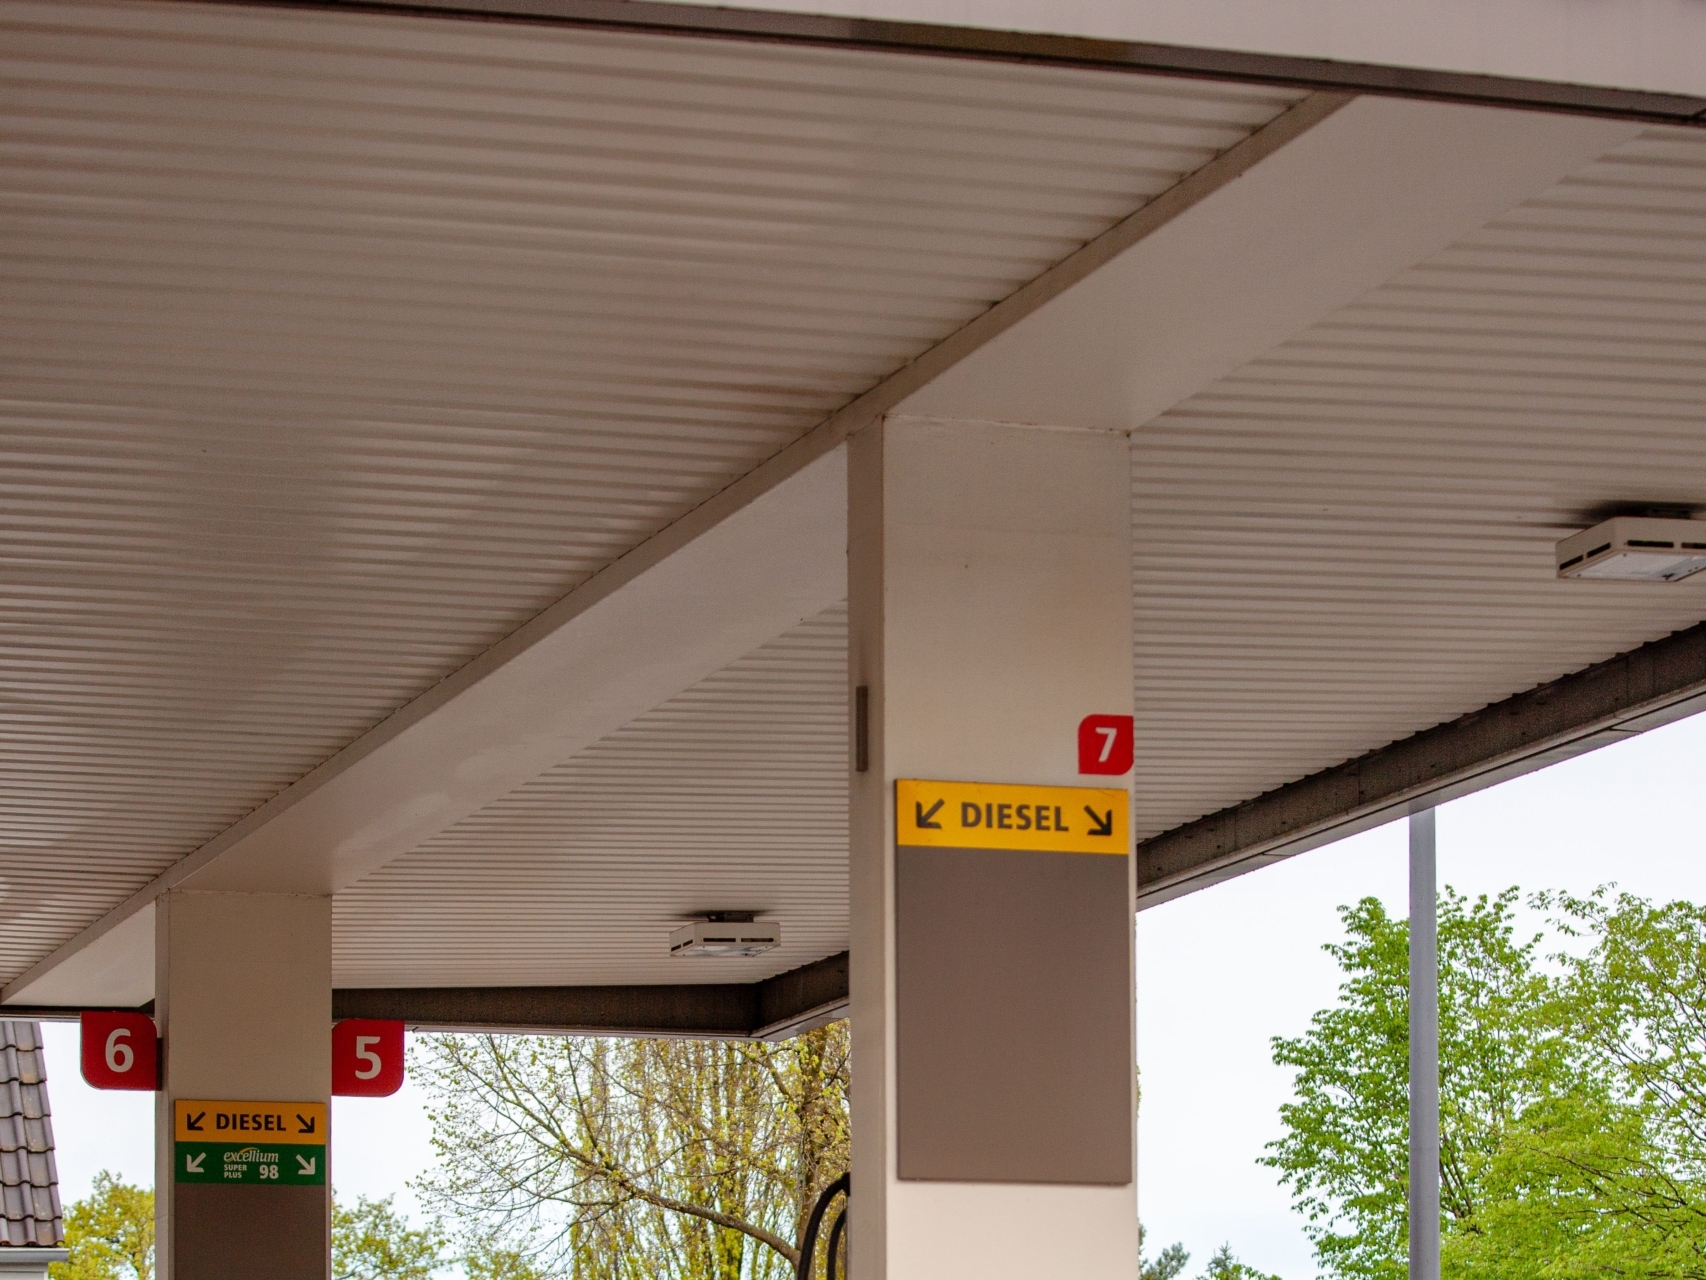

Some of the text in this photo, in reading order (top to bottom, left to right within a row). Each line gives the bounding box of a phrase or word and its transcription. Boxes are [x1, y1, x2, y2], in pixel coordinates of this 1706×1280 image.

[1095, 726, 1118, 763] 7
[961, 801, 1070, 832] DIESEL
[105, 1027, 135, 1073] 6
[354, 1035, 382, 1080] 5
[216, 1113, 287, 1132] DIESEL
[223, 1148, 279, 1163] excellium
[223, 1164, 248, 1172] SUPER
[223, 1171, 243, 1179] PLUS
[259, 1164, 280, 1180] 98
